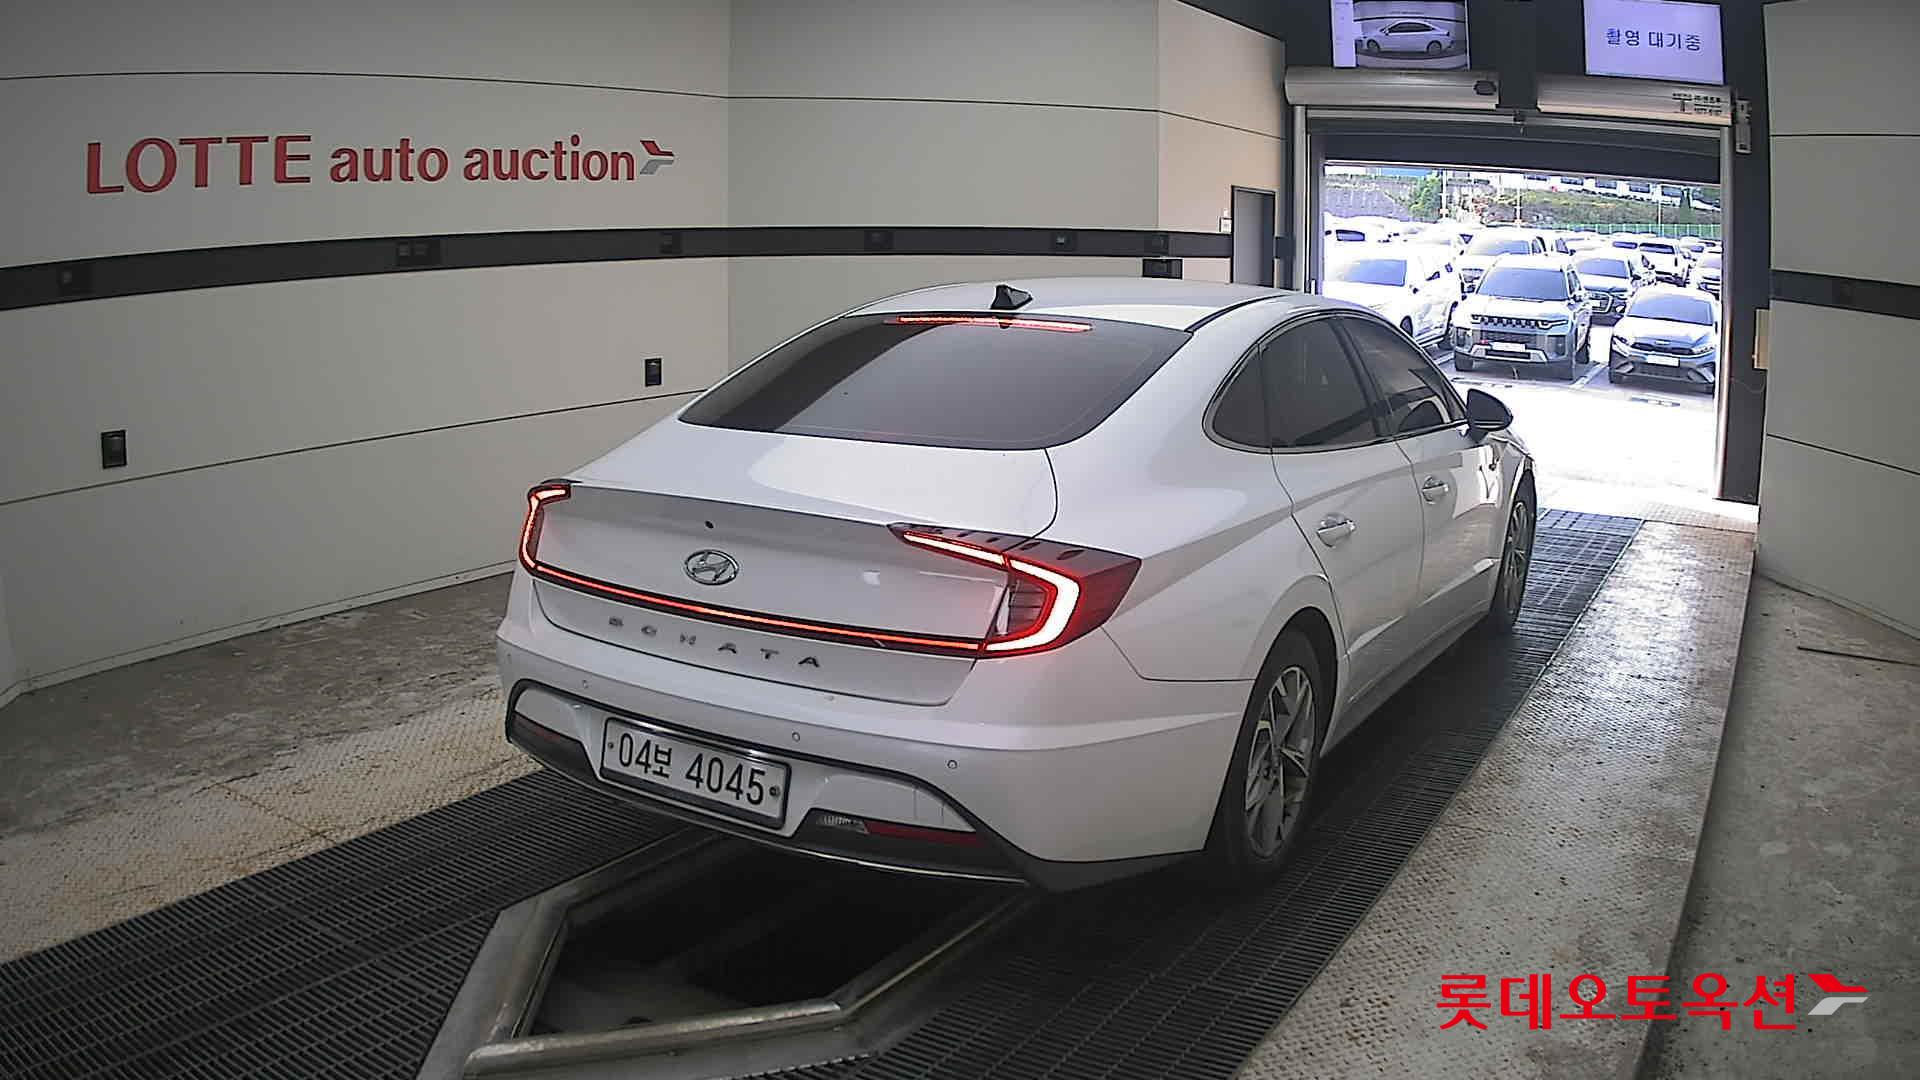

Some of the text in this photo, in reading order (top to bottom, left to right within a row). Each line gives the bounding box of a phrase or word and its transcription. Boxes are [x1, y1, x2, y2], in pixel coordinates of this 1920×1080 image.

[1607, 28, 1702, 51] 촬영 대기중
[86, 134, 635, 194] LOTTE auto auction
[608, 618, 820, 668] SONATA
[618, 732, 766, 805] 04보 4045
